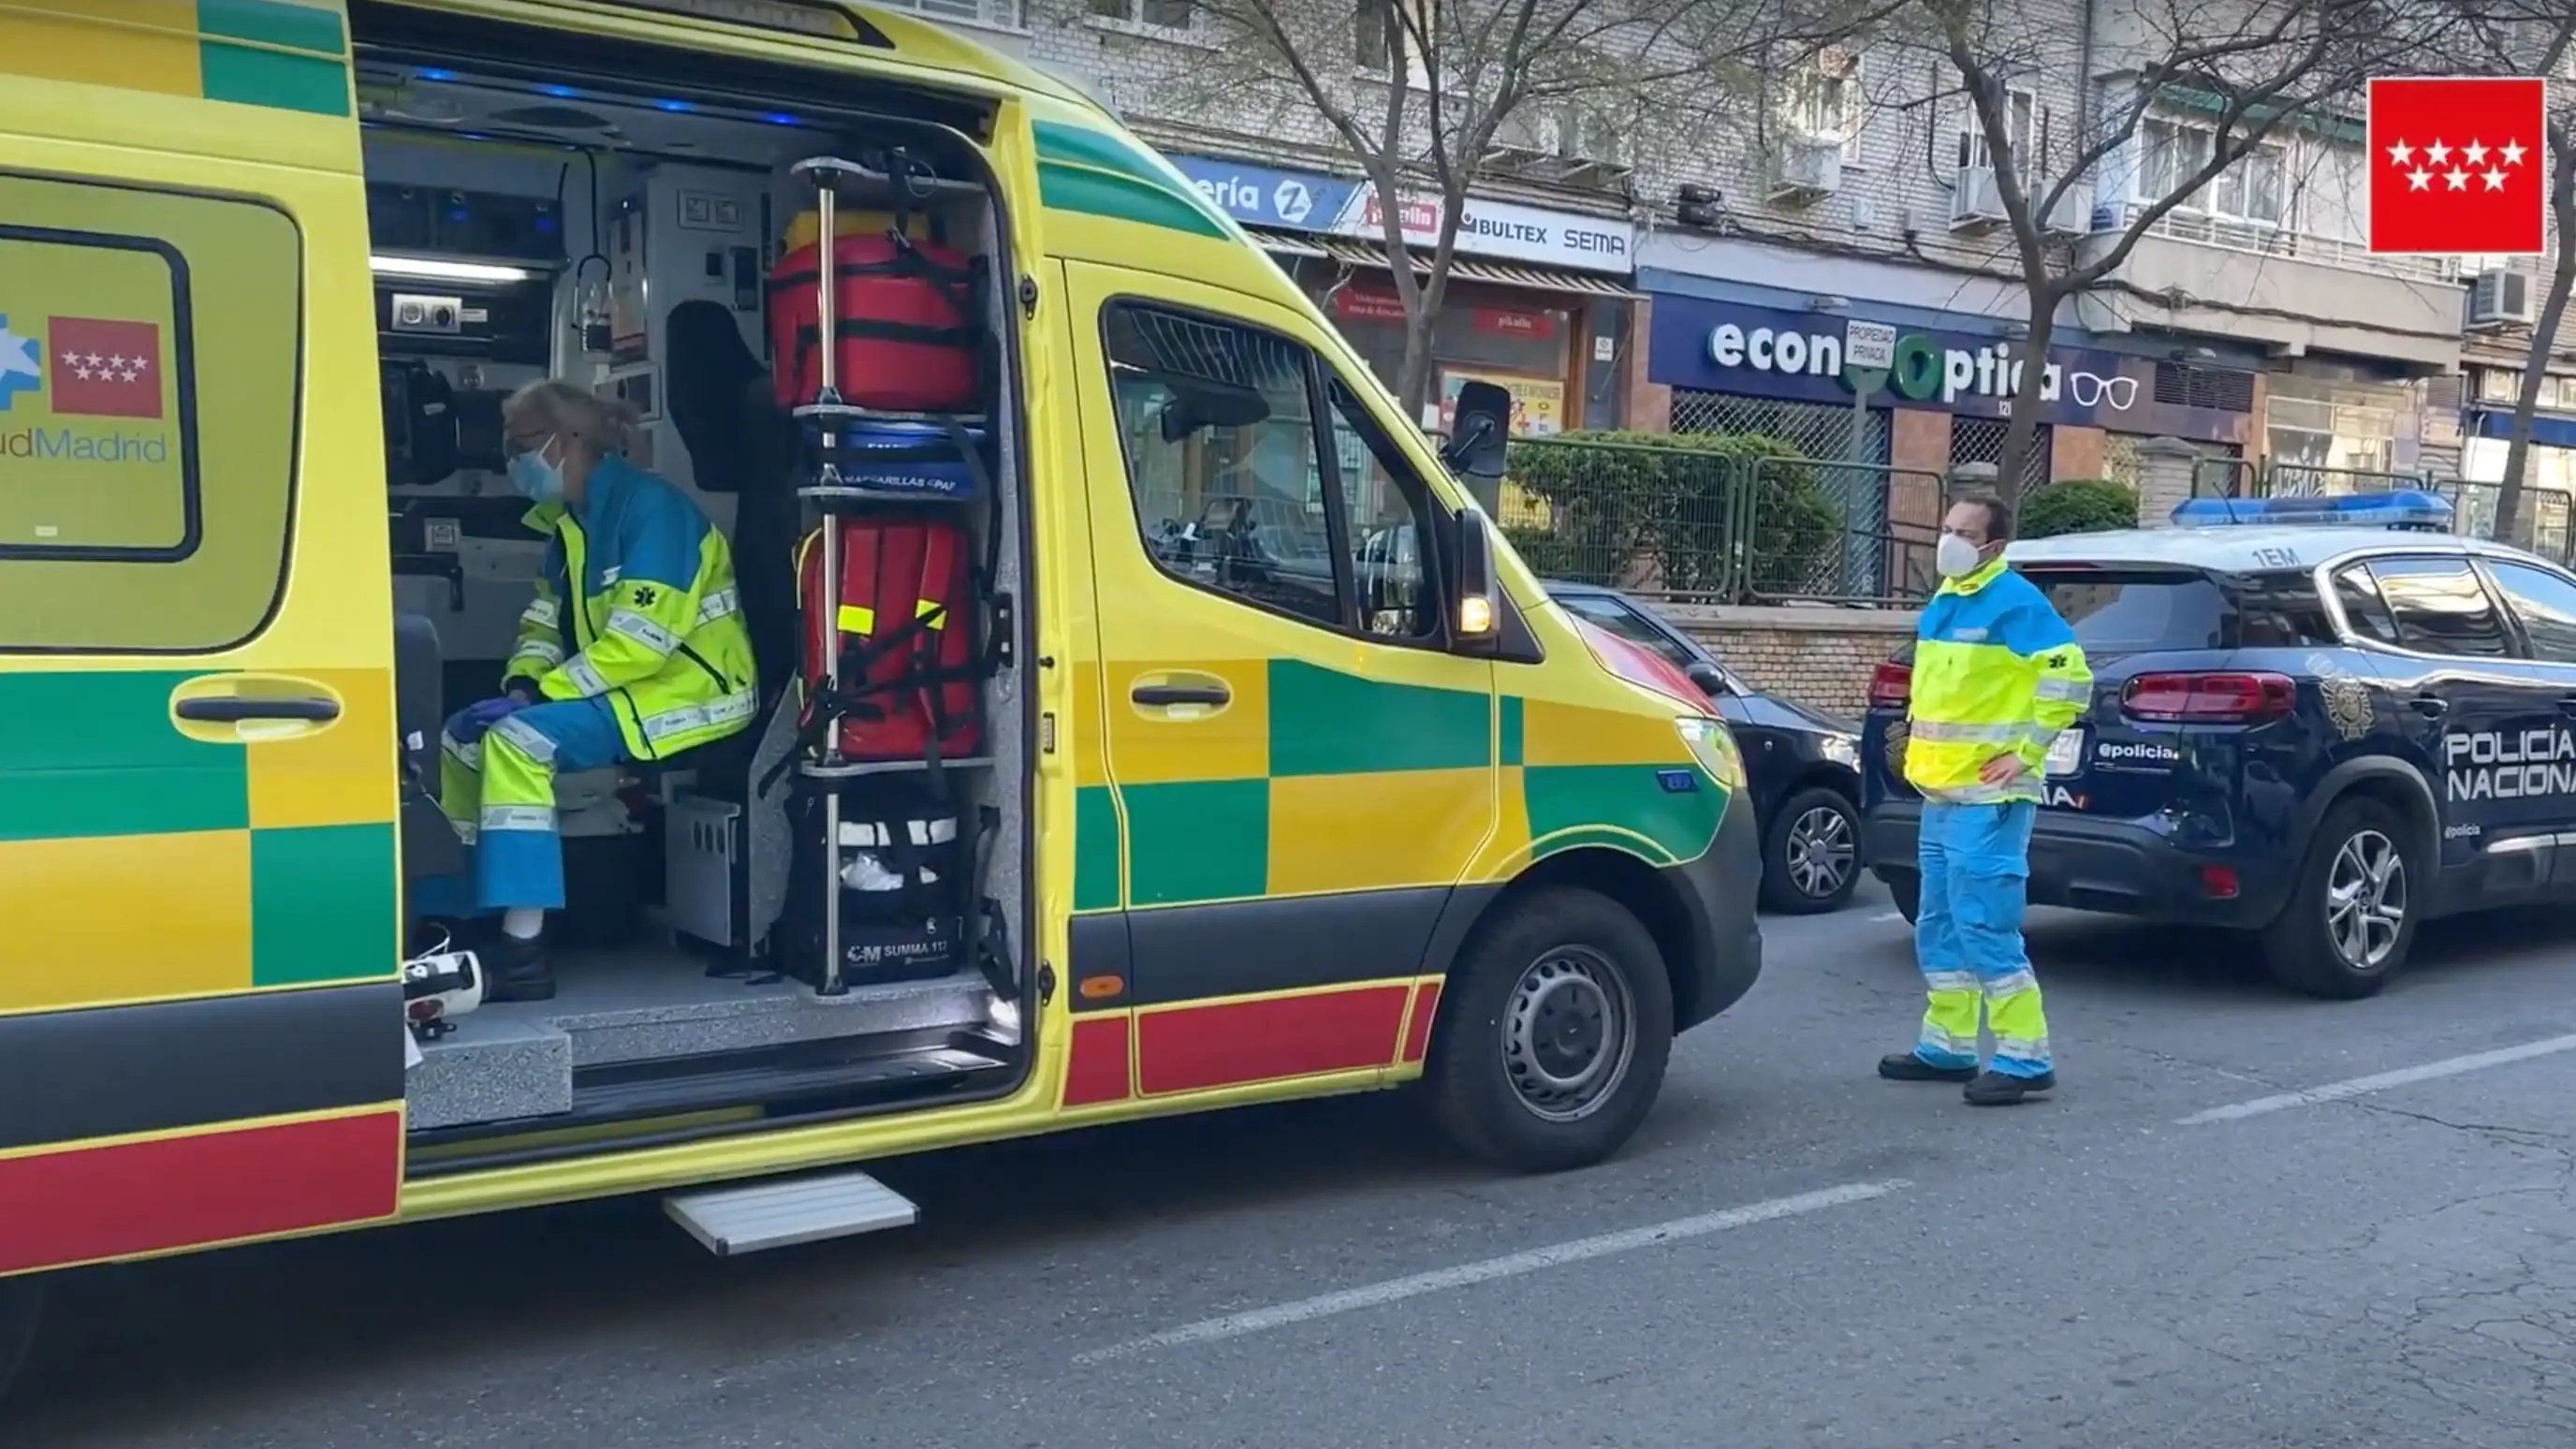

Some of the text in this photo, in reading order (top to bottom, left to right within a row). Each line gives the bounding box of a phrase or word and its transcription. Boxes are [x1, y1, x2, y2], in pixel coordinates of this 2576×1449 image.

[1479, 219, 1625, 255] BULTEX SEMA
[1849, 325, 1895, 344] PROPIEDAD
[1853, 344, 1885, 362] PRIVADA
[2251, 547, 2301, 567] 1EM
[2447, 723, 2576, 766] POLICÍA
[884, 943, 929, 958] SUMMA
